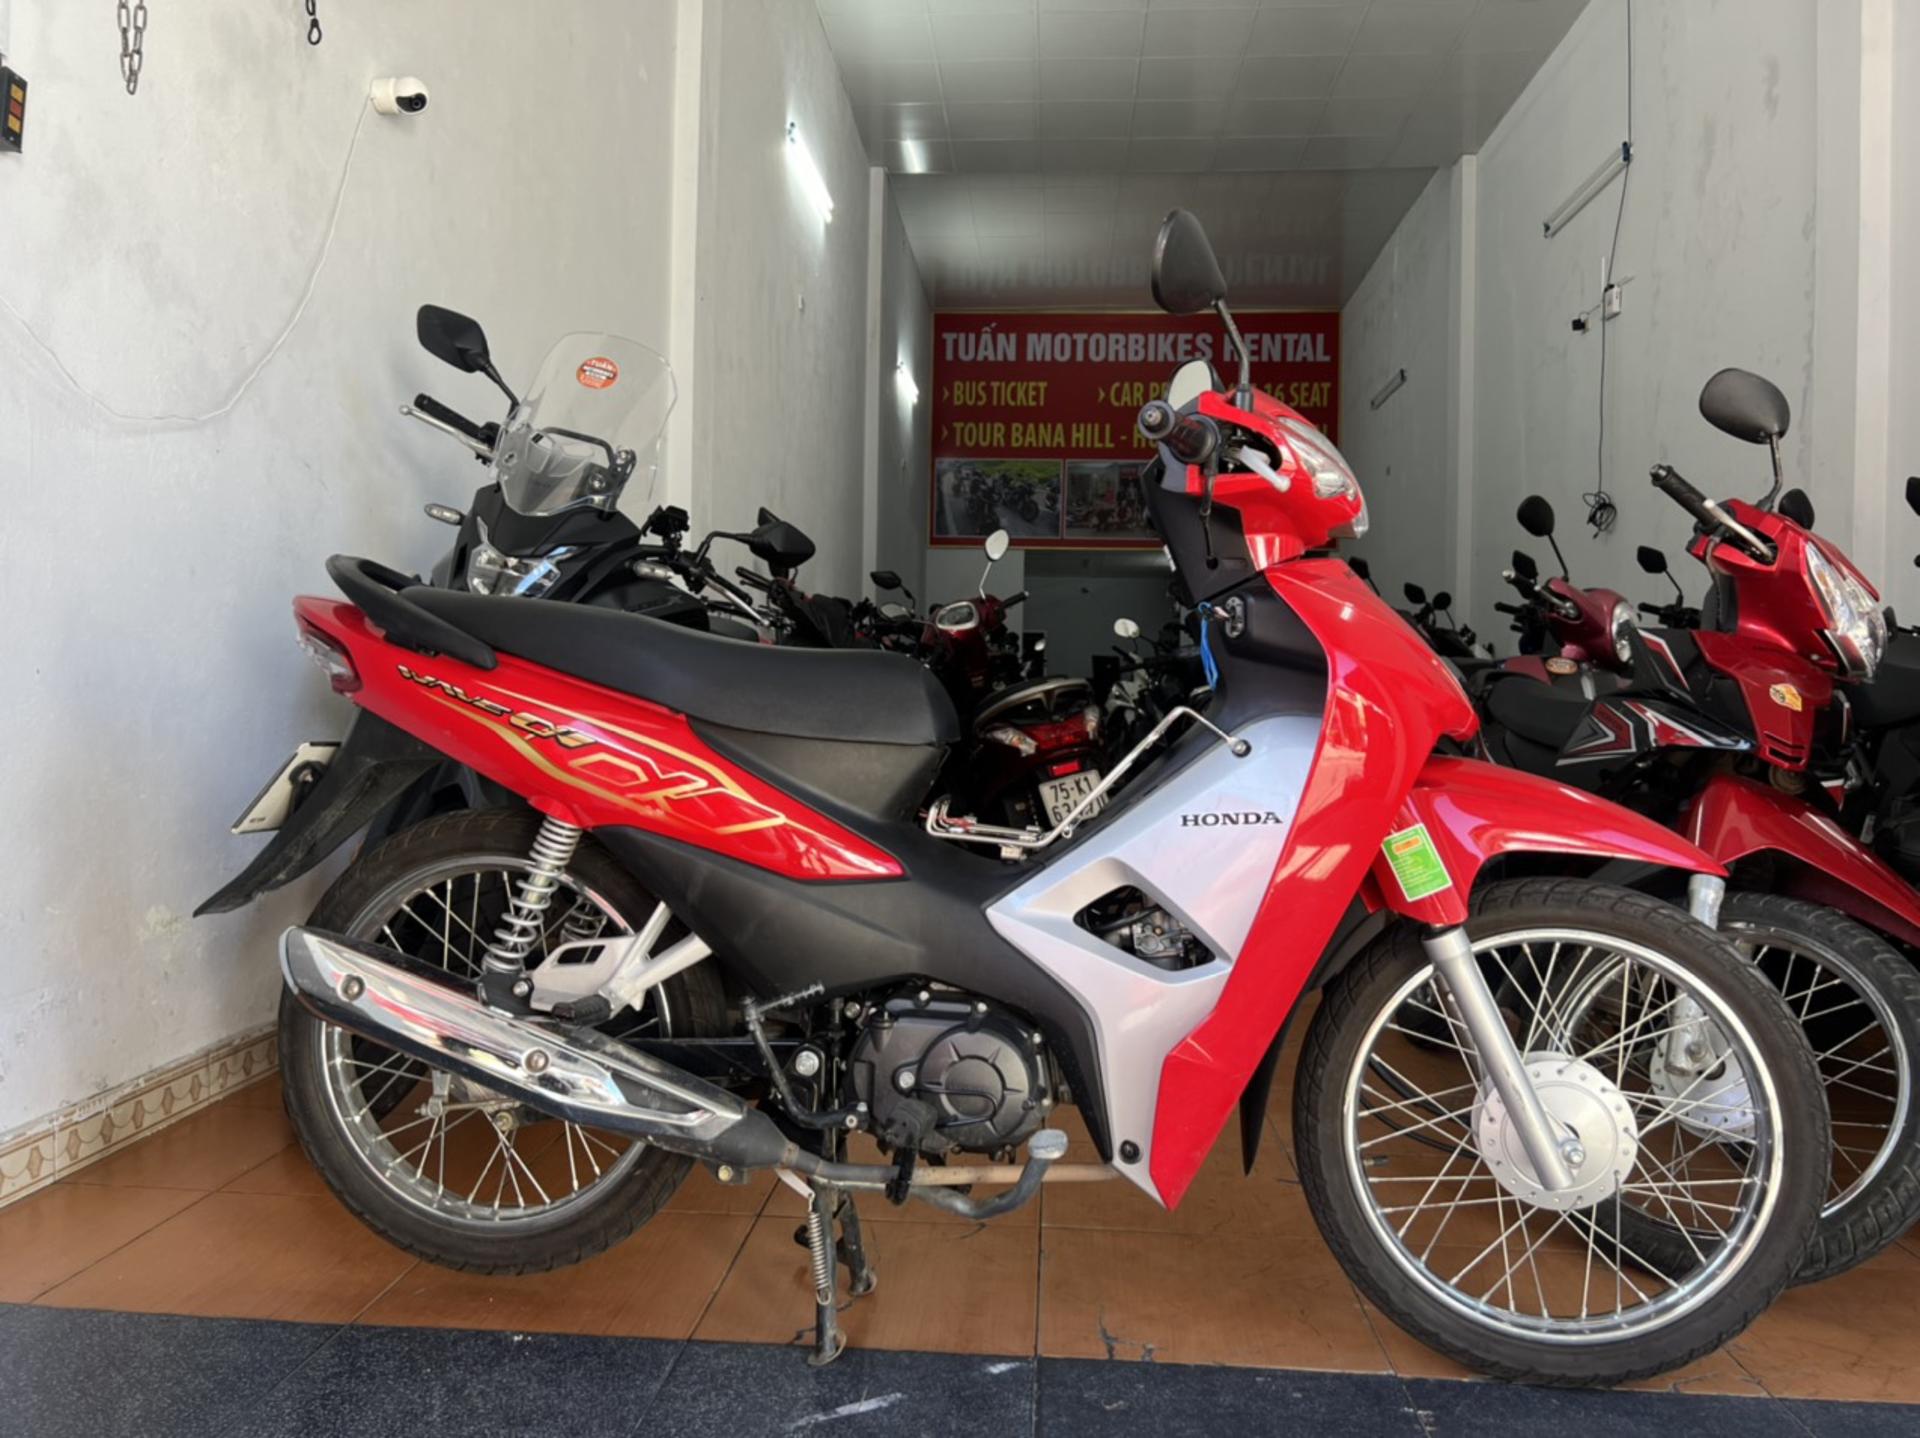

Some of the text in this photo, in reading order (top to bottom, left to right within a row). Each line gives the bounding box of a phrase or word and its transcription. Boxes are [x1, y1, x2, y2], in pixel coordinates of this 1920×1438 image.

[942, 322, 1017, 362] TUẤN
[1026, 332, 1213, 362] MOTORBIKES
[953, 381, 1048, 406] BUS TICKET
[1110, 381, 1144, 407] CAR
[1289, 382, 1331, 407] SEAT
[953, 422, 1005, 447] TOUR
[1011, 422, 1065, 448] BANA
[1071, 423, 1115, 448] HILL
[1180, 811, 1284, 827] HONDA
